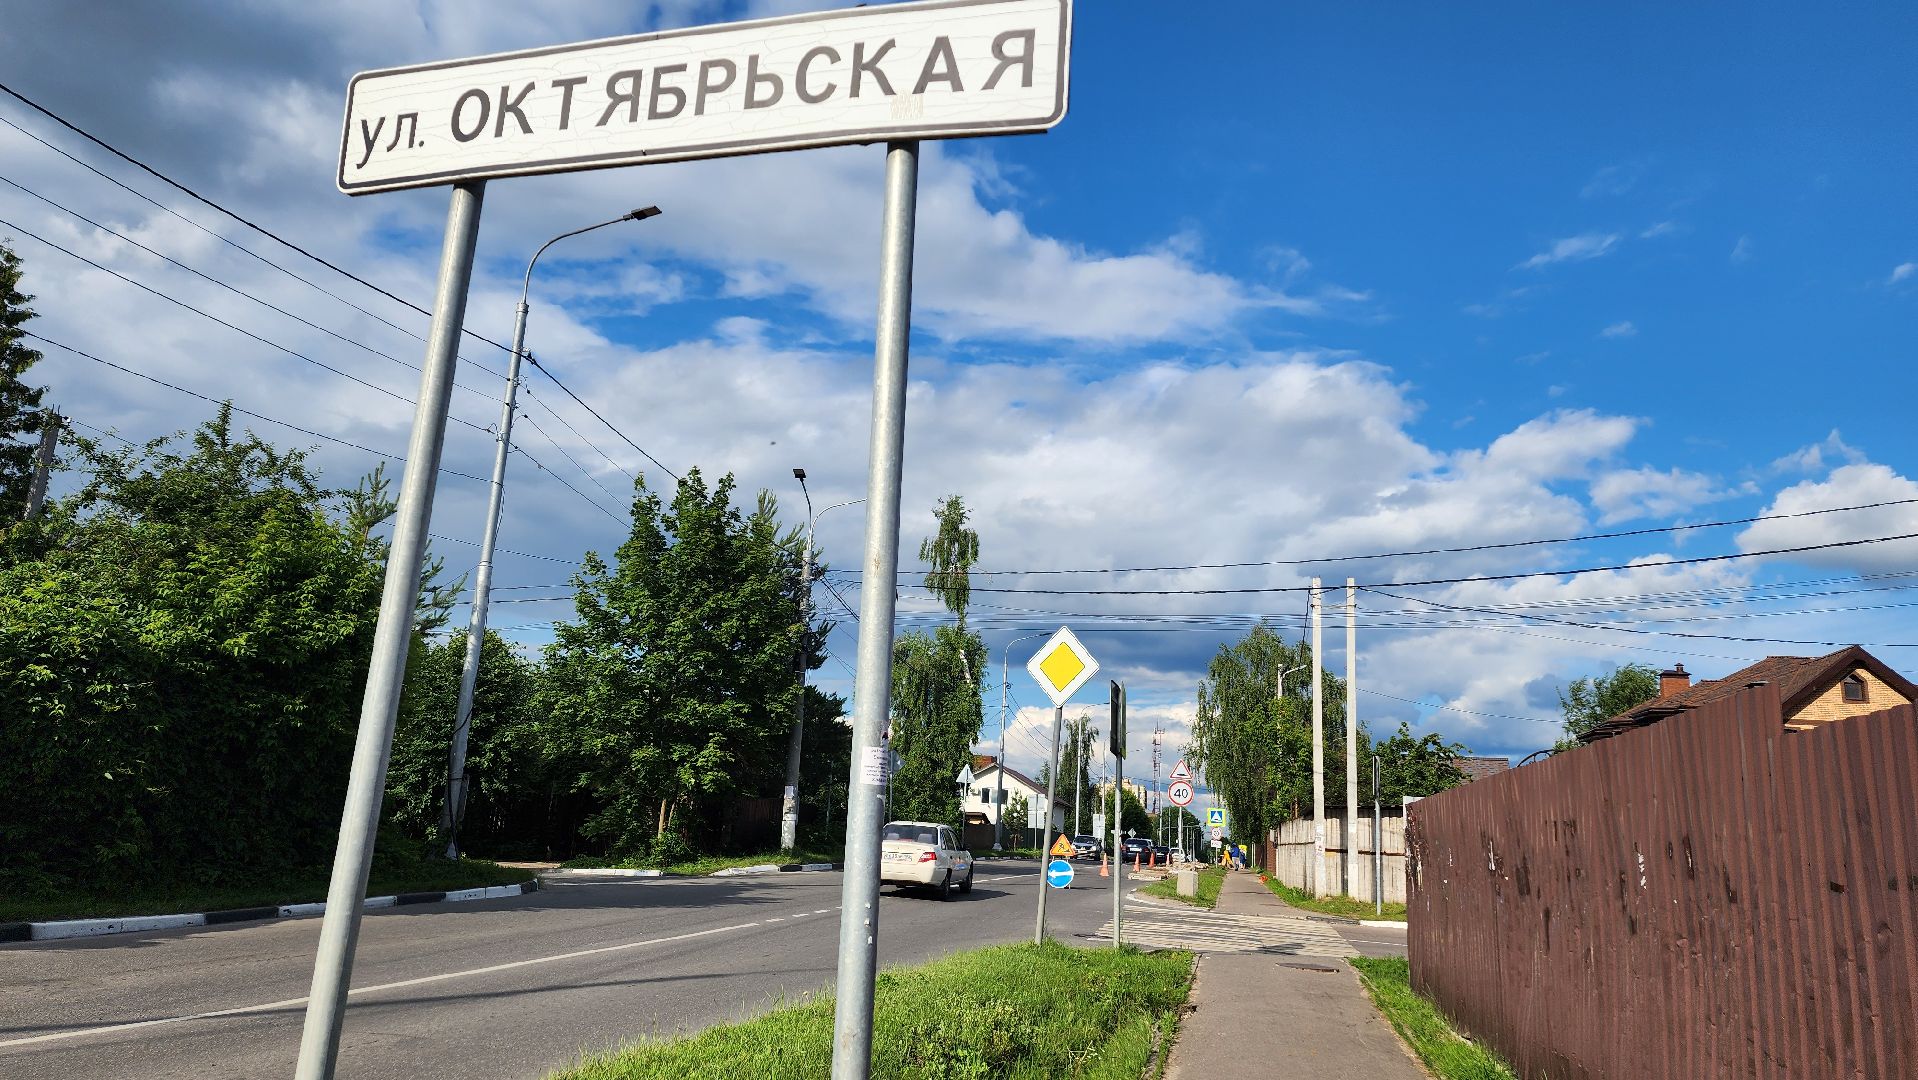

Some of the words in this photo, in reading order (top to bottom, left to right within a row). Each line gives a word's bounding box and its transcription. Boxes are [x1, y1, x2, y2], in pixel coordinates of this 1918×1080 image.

[356, 112, 425, 169] ул.
[451, 28, 1036, 142] ОКТЯБРЬСКАЯ
[1173, 788, 1188, 799] 40
